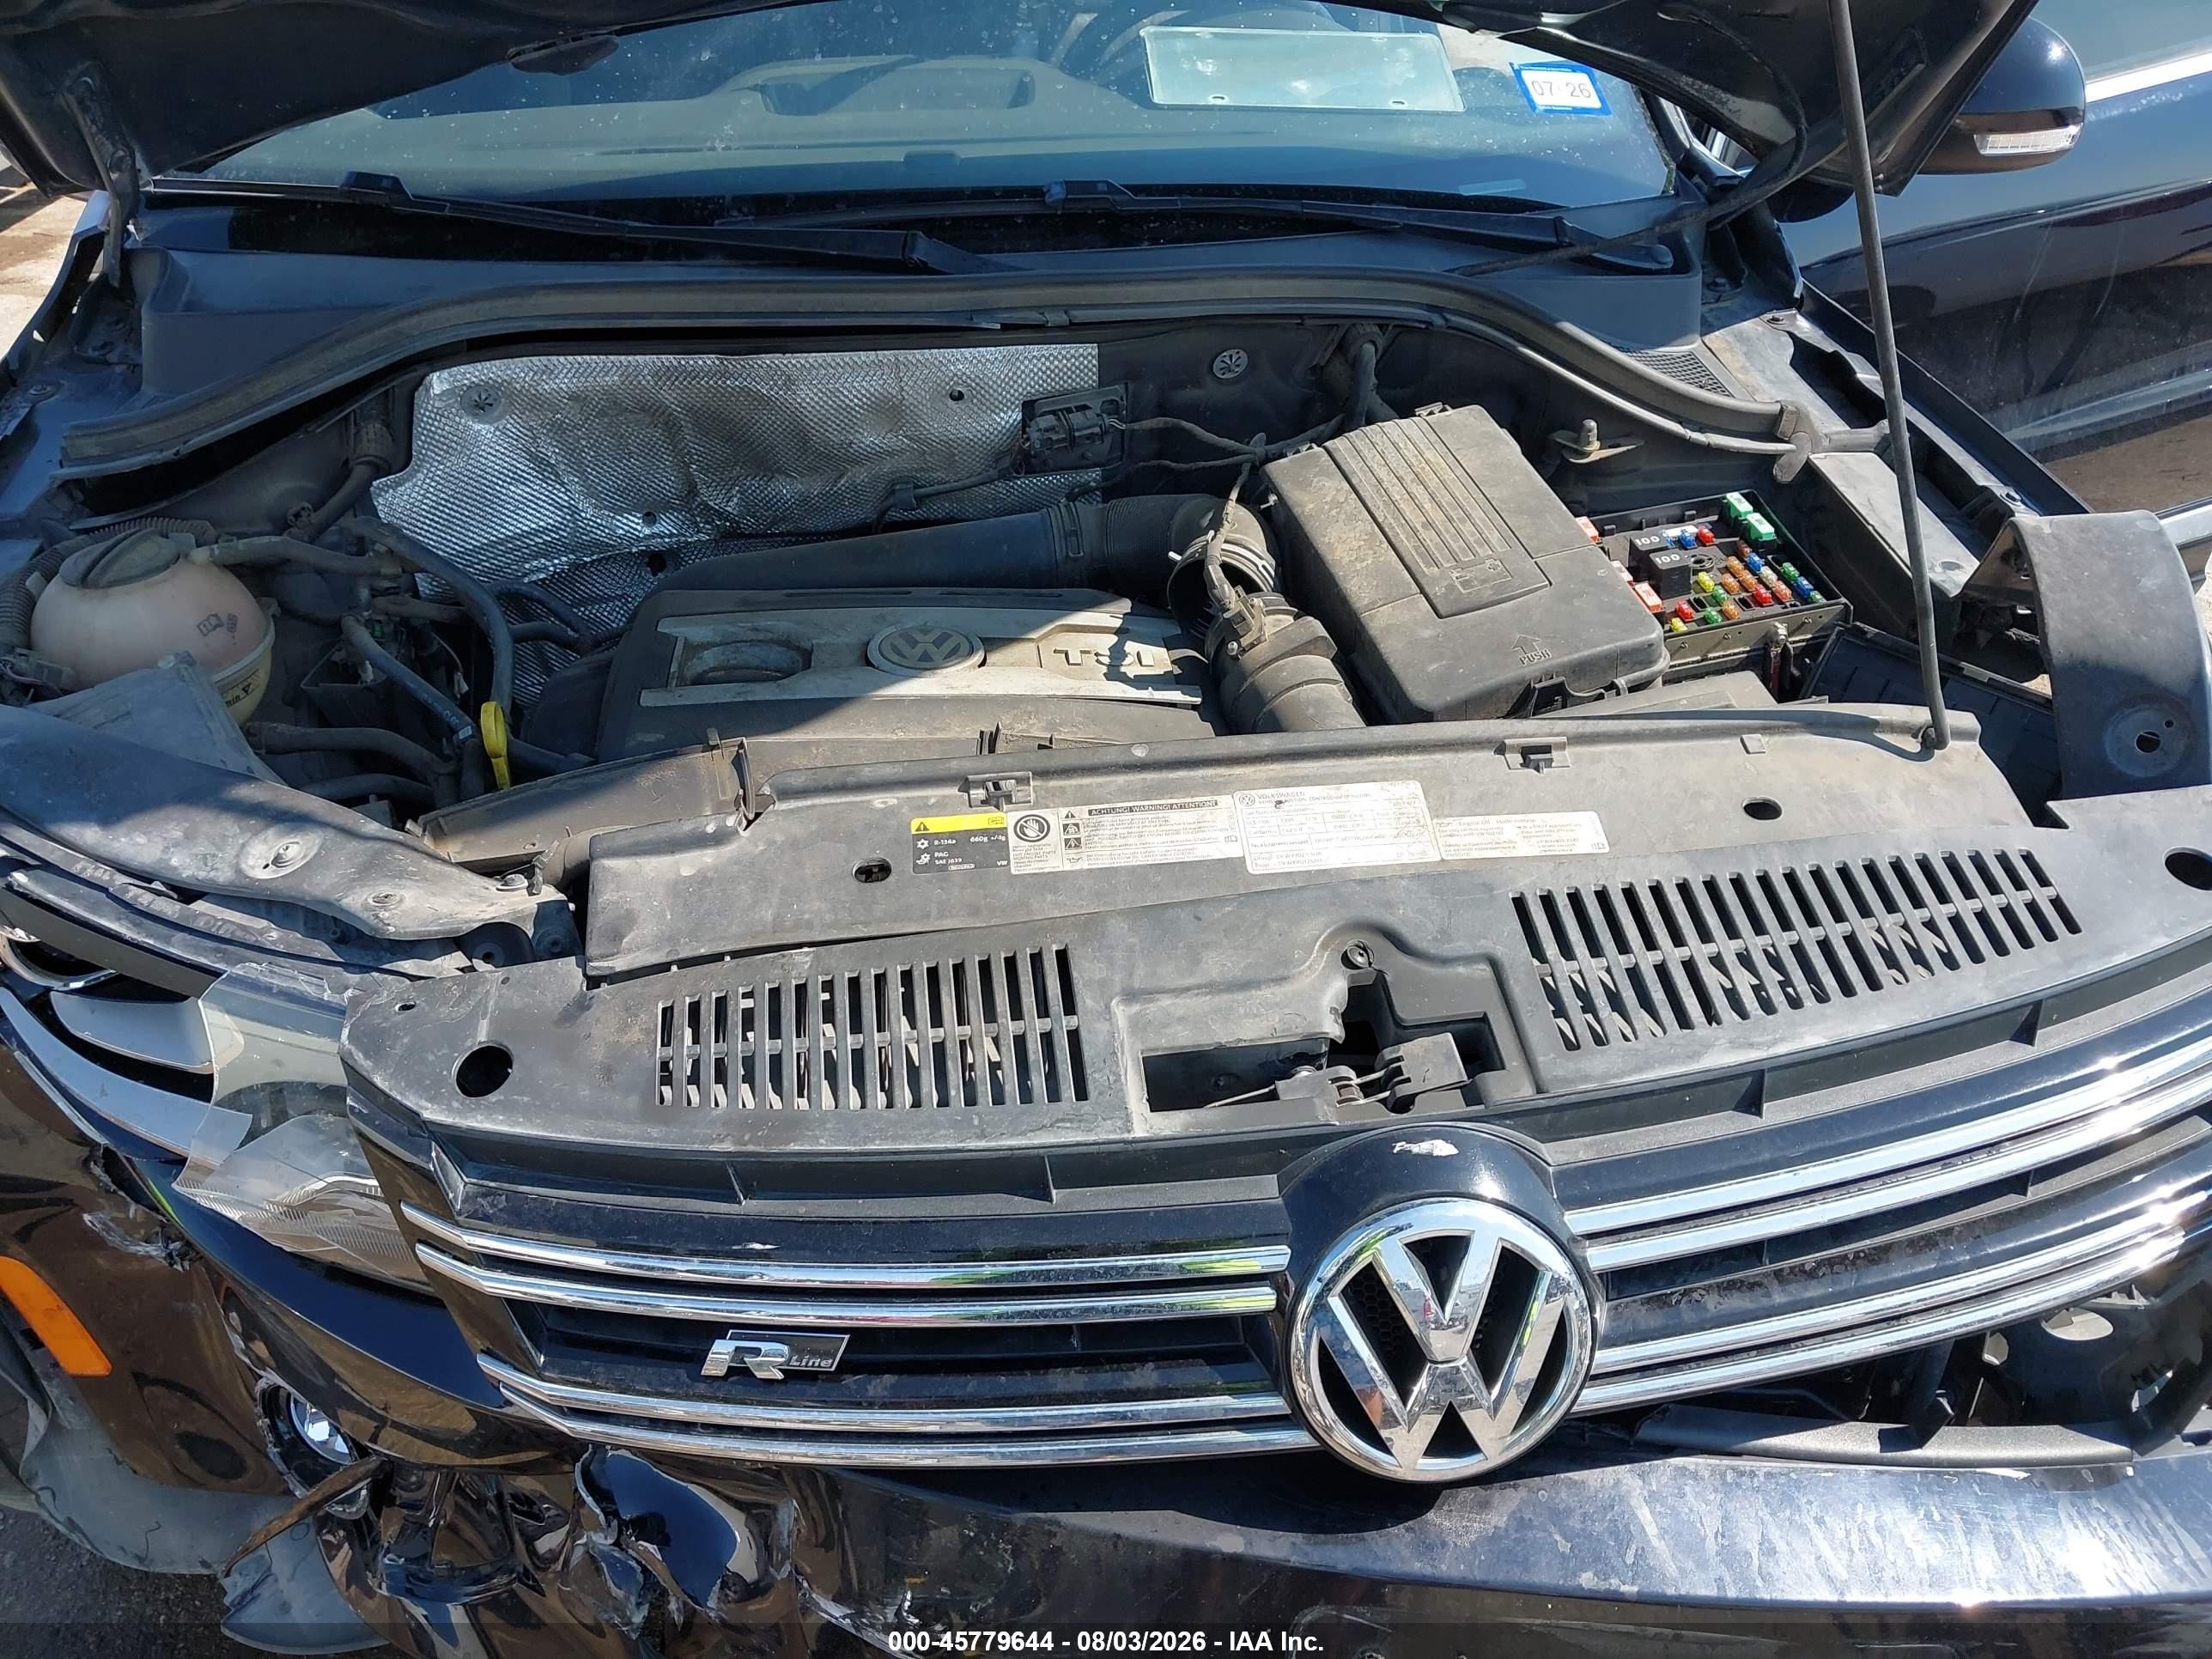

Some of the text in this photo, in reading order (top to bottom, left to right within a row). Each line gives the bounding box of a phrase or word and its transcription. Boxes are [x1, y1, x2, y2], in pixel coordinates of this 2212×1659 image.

[1531, 80, 1591, 98] 07 26
[1634, 535, 1660, 545] 100
[1655, 554, 1680, 564] 100
[1053, 648, 1155, 667] TSI
[1519, 648, 1552, 665] PUSH
[1091, 807, 1131, 816] ACHTUNG!
[1132, 804, 1171, 812] WARNING!
[789, 1355, 834, 1368] Line
